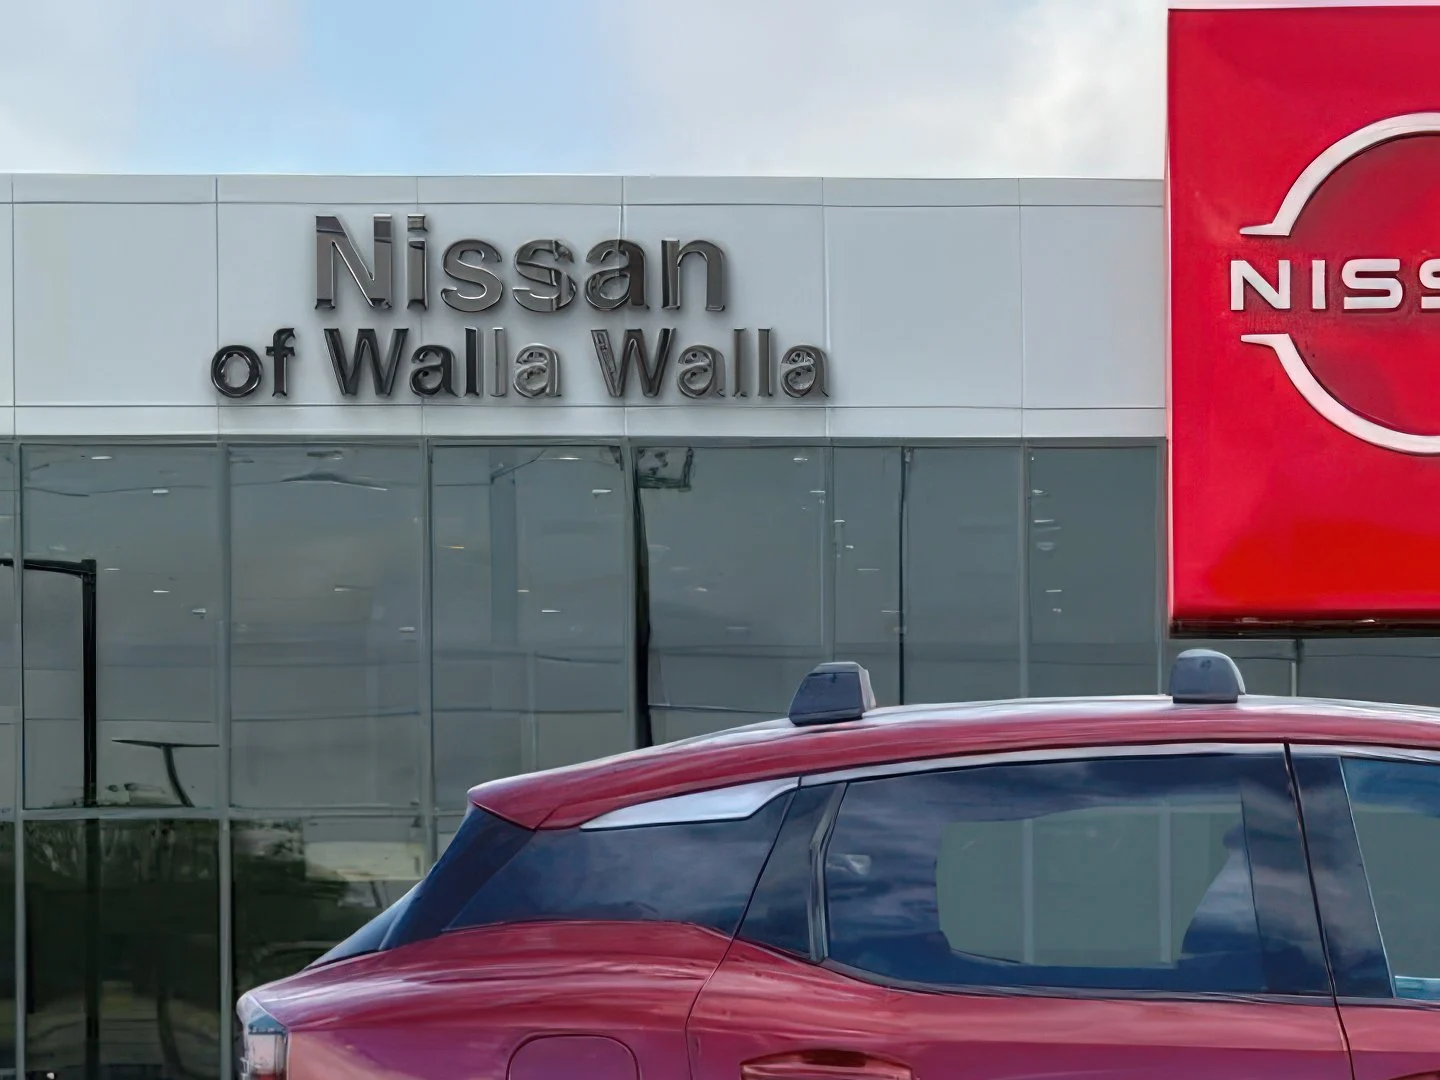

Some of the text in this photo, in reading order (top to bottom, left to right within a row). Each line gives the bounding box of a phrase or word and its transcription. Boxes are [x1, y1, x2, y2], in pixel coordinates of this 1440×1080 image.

[314, 214, 726, 311] Nissan
[210, 327, 830, 398] of Walla Walla
